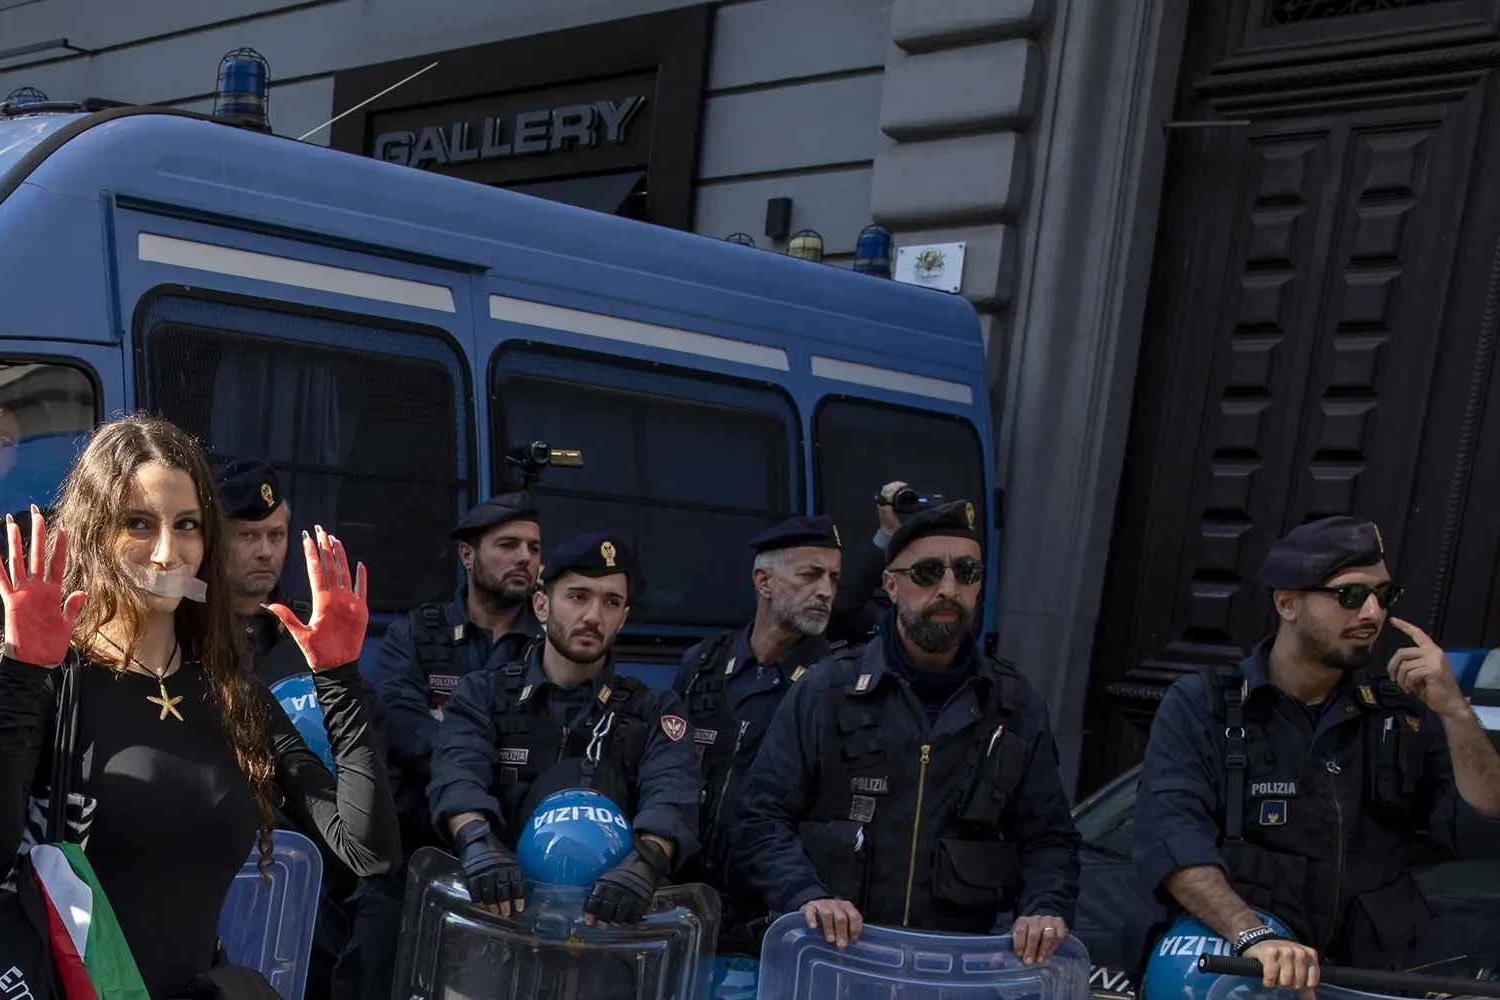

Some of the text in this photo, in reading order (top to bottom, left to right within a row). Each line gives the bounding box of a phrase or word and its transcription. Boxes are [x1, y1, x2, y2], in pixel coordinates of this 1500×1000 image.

[374, 96, 644, 167] GALLERY
[430, 677, 458, 688] POLIZIA
[851, 777, 888, 792] POLIZIA
[1251, 782, 1296, 795] POLIZIA
[534, 806, 628, 830] POLIZIA
